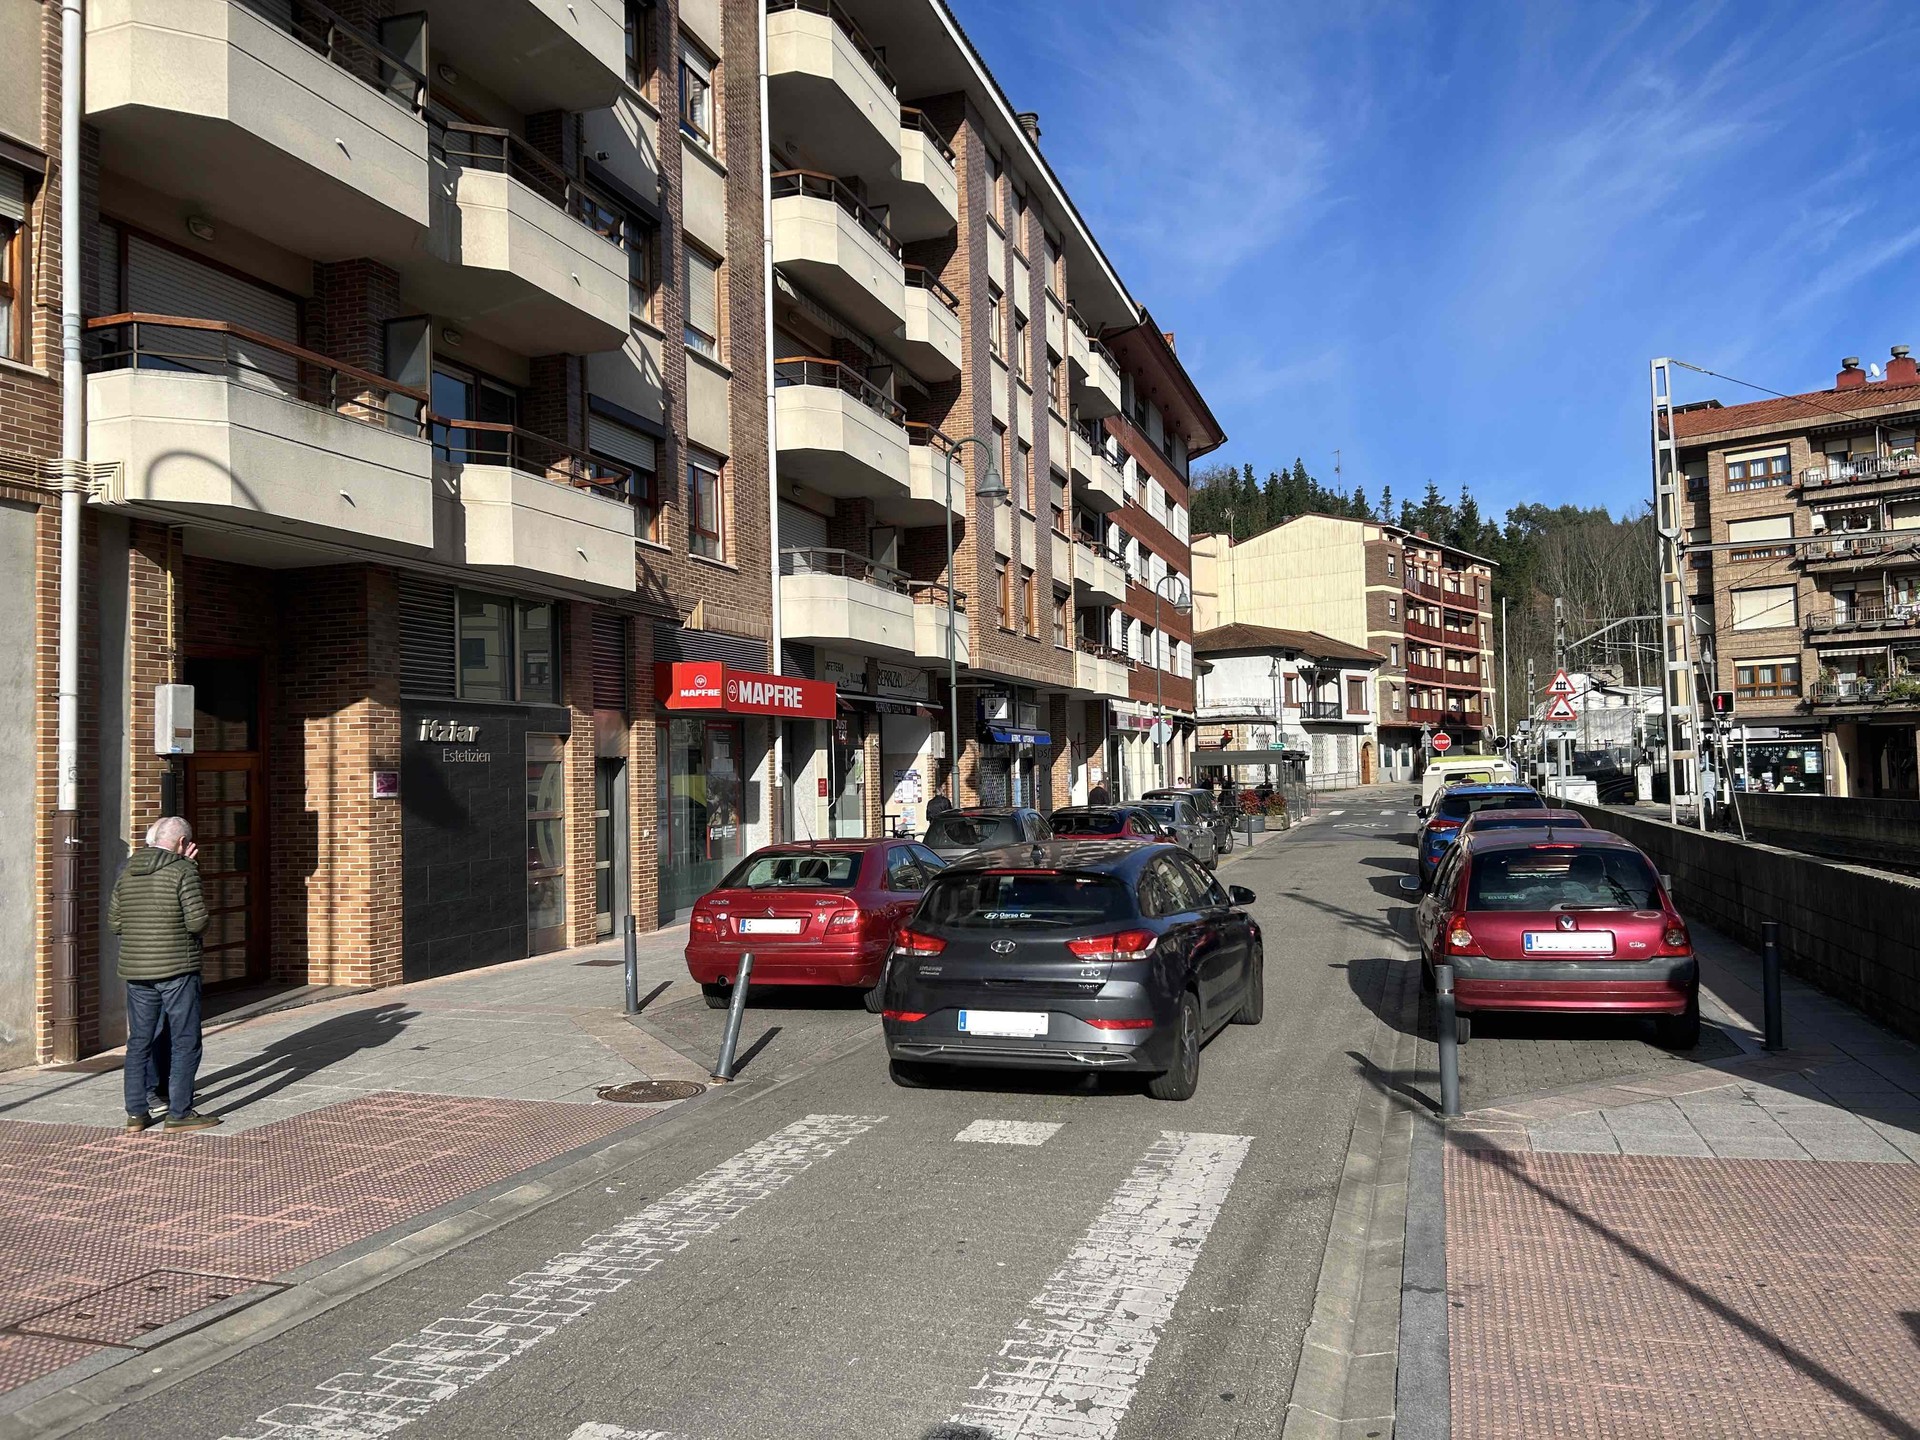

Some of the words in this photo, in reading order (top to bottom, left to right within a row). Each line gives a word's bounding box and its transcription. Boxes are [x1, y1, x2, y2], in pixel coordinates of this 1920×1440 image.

[681, 689, 721, 697] MAPFRE
[739, 680, 803, 709] MAPFRE
[836, 720, 848, 730] JUST
[838, 730, 848, 740] EAT
[442, 748, 491, 763] Estetizien
